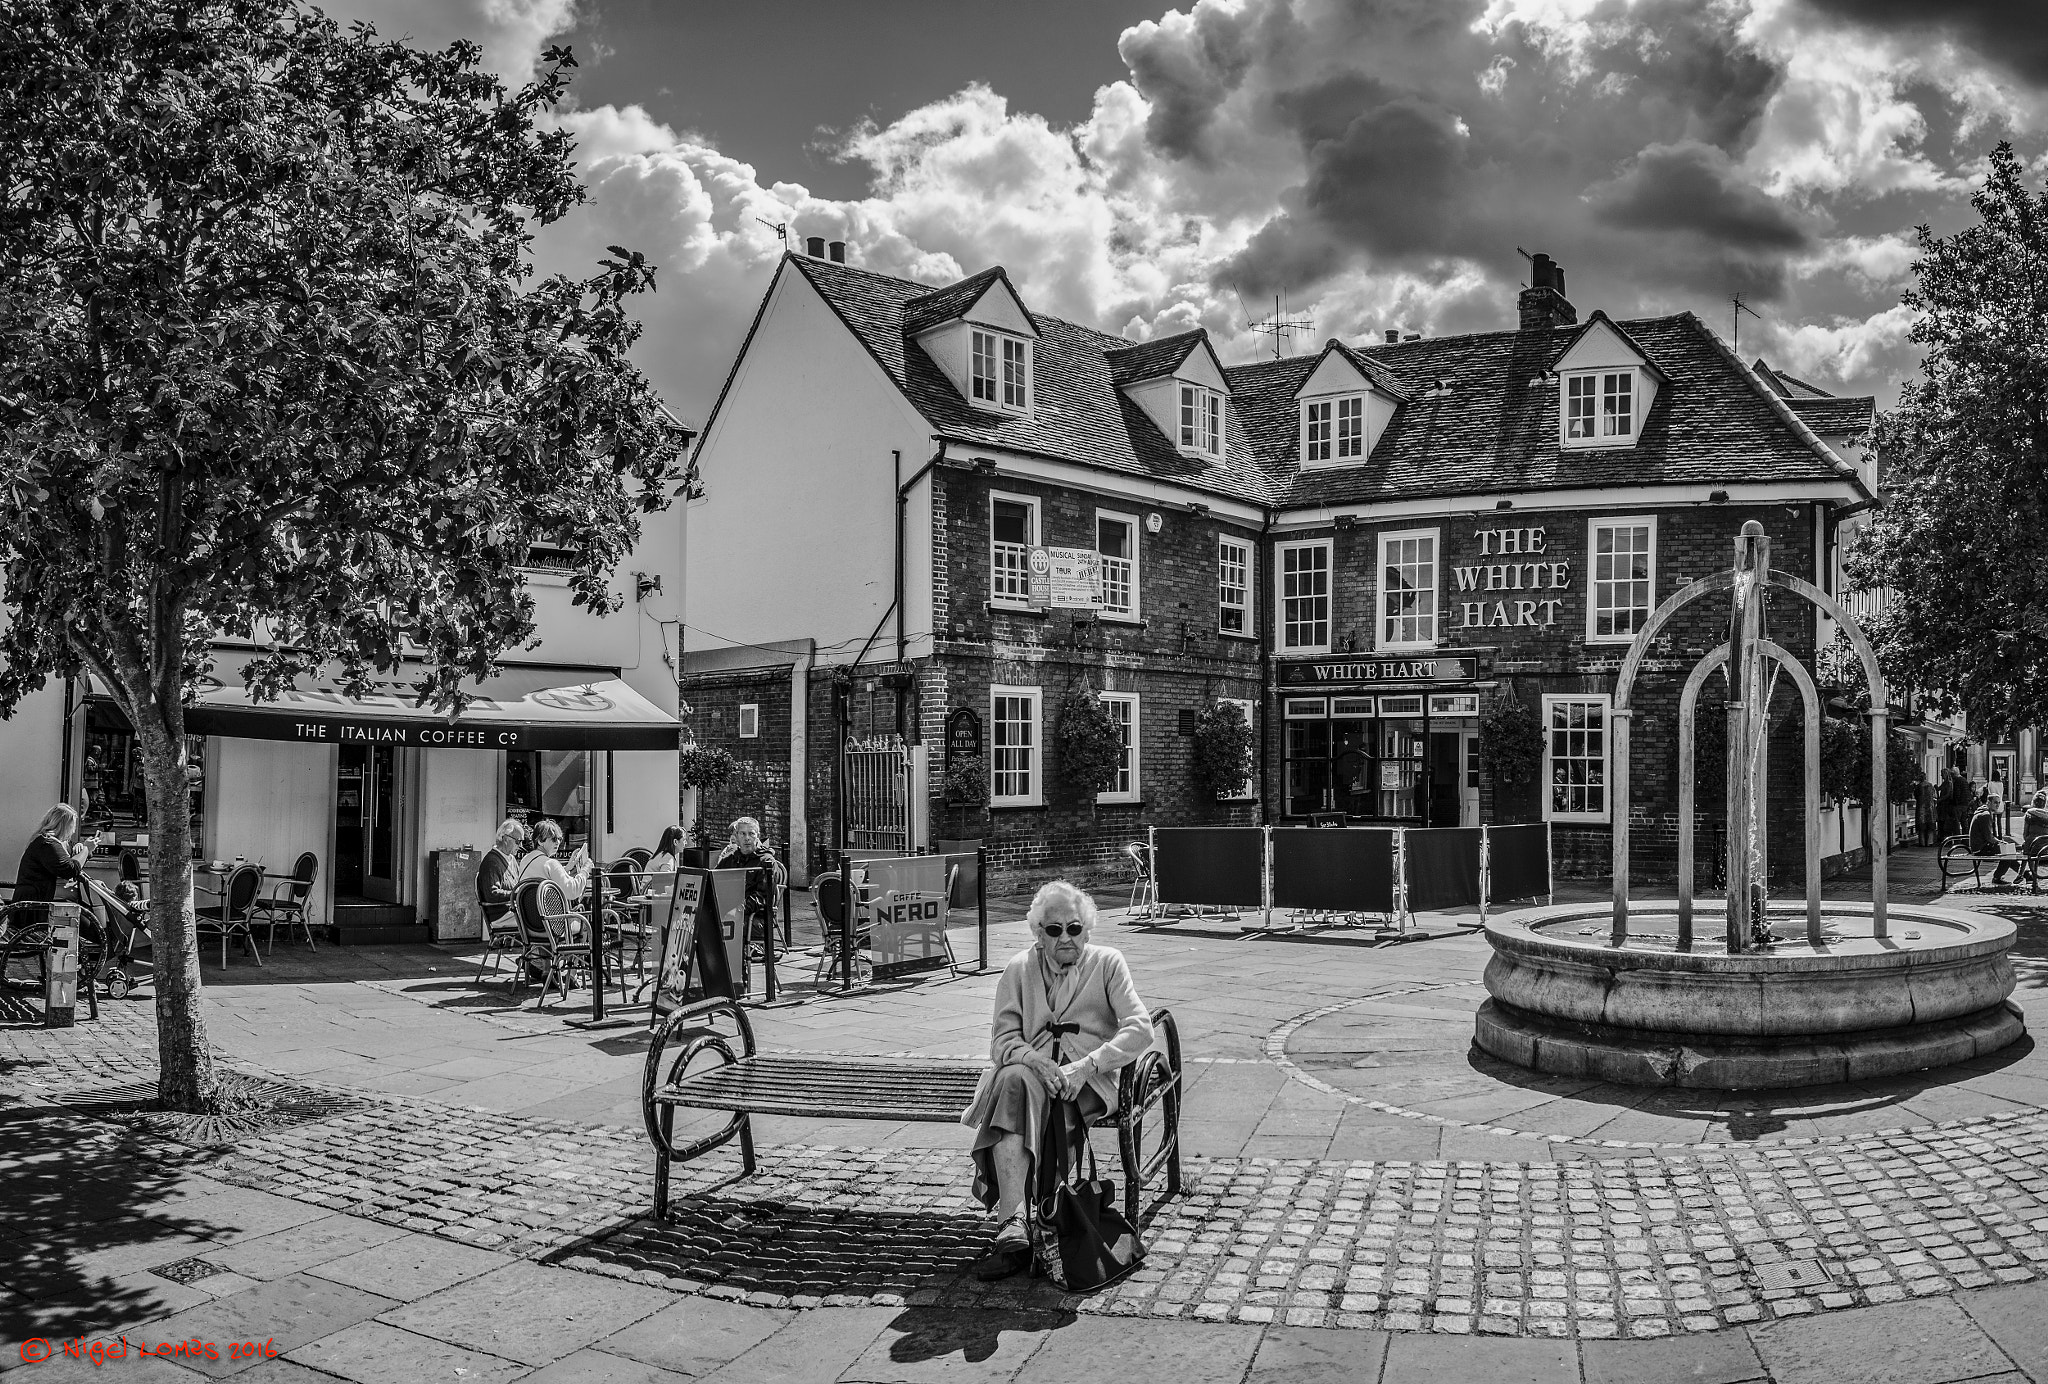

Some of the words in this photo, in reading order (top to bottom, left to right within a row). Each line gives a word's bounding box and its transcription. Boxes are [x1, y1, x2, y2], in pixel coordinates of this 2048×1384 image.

[1473, 525, 1547, 555] THE
[1050, 551, 1075, 560] MUSICAL
[1055, 567, 1072, 575] TOUR
[1453, 561, 1571, 592] WHITE
[1461, 598, 1563, 628] HART
[1313, 663, 1377, 680] WHITE
[1381, 661, 1439, 679] HART
[296, 723, 327, 738] THE
[340, 725, 406, 742] ITALIAN
[420, 729, 485, 745] COFFEE
[679, 888, 698, 902] NERO
[876, 901, 939, 926] NERO
